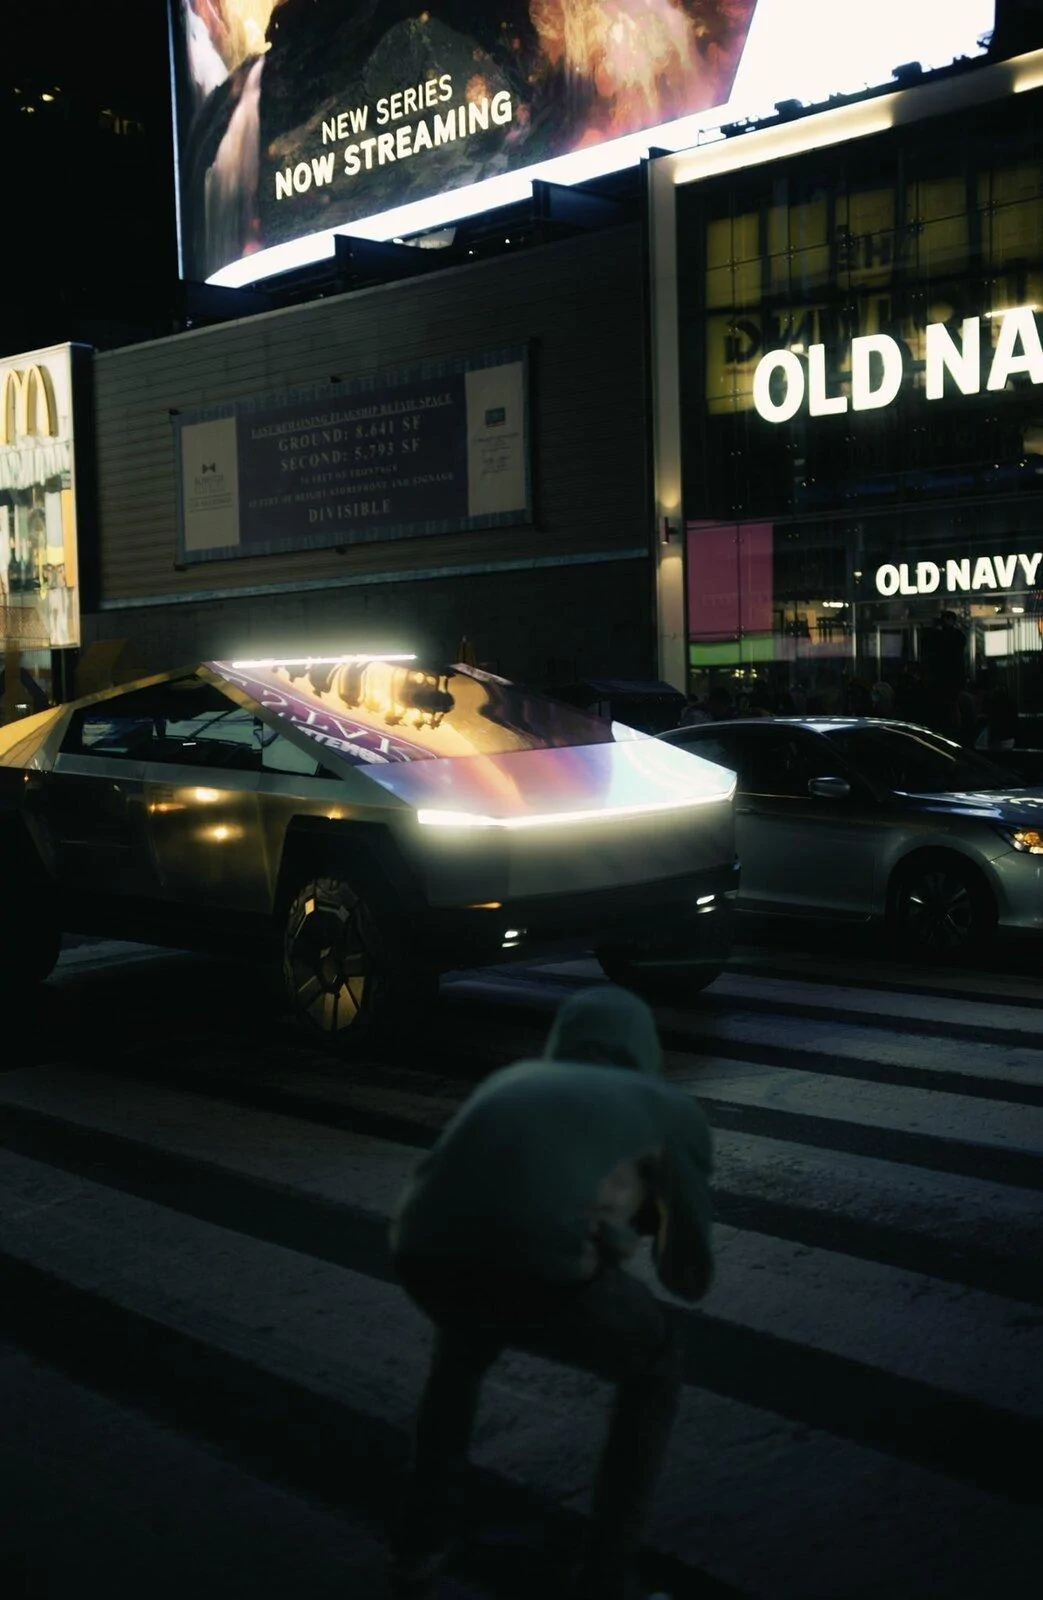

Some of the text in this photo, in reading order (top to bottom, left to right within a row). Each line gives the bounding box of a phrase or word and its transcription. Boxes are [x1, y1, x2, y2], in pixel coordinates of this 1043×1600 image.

[322, 74, 453, 145] NEW SERIES
[275, 90, 513, 200] NOW STREAMING
[753, 334, 903, 423] OLD
[418, 392, 453, 409] SPACE
[278, 428, 349, 452] GROUND:
[403, 416, 422, 432] SF
[280, 451, 348, 472] SECOND:
[402, 438, 421, 454] SF
[308, 499, 391, 524] DIVISIBLE
[876, 552, 1043, 597] OLD NAVY
